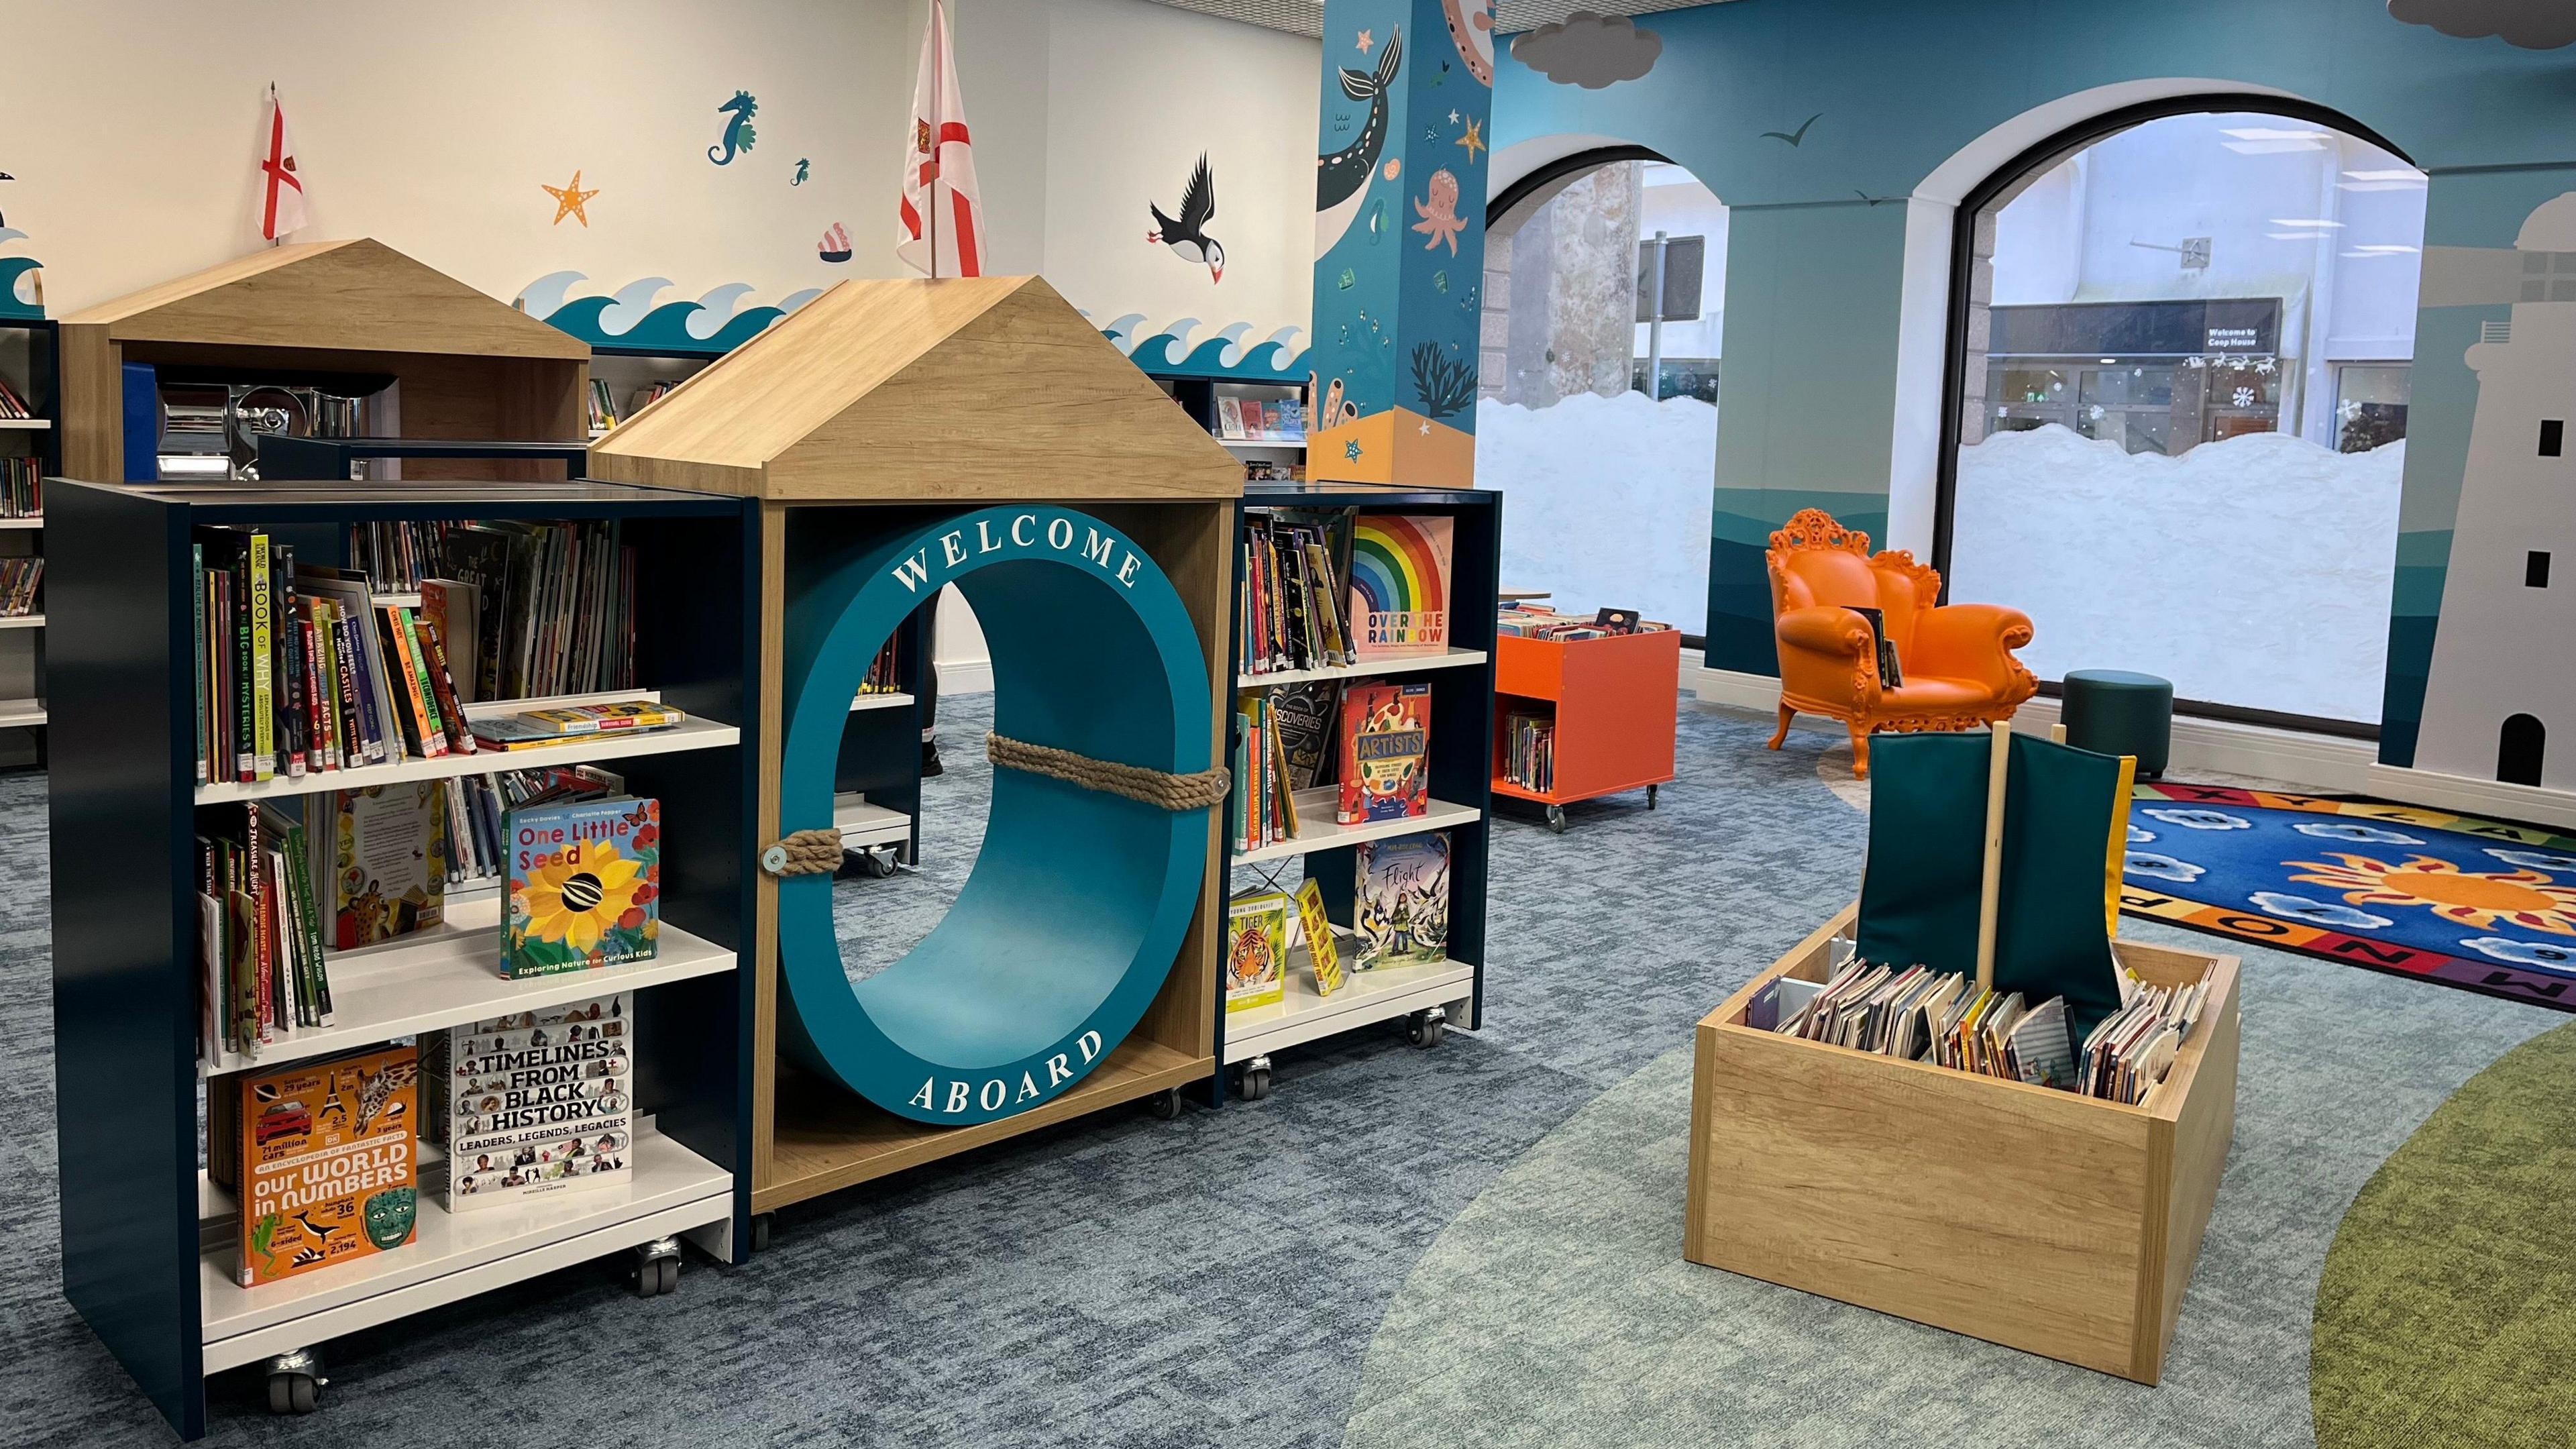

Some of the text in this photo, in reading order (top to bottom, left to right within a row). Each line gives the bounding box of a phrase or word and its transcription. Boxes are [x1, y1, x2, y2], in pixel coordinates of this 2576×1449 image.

[2208, 338, 2256, 347] Coop House
[892, 515, 1141, 593] WELCOME
[458, 569, 487, 588] GREAT
[1368, 613, 1442, 628] OVER THE
[239, 627, 250, 649] BIG
[255, 584, 270, 691] BOOK OF WHY
[339, 606, 356, 675] HOW DO YOU FEEL?
[1368, 629, 1442, 643] RAINBOW
[391, 611, 419, 698] CHRIS HOY BE AMAZING!
[409, 637, 426, 673] MIDDLETON
[435, 645, 446, 666] GHOSTS
[315, 628, 327, 669] AMAZING
[322, 700, 332, 731] FACTS
[335, 638, 356, 737] Haunted CASTLES YVETTE
[242, 682, 252, 741] MYSTERIES
[567, 722, 597, 731] Friendship
[2184, 788, 2241, 802] X
[2273, 794, 2315, 807] Y
[600, 809, 622, 817] Pepper
[2176, 814, 2228, 825] 10
[519, 819, 629, 846] One Little
[2466, 826, 2524, 841] A
[519, 845, 580, 871] Seed
[2132, 859, 2169, 869] 8
[250, 871, 259, 896] HUNT
[1381, 860, 1426, 891] Flight
[1230, 902, 1274, 915] YOUNG ZOOLOGIST
[1240, 914, 1263, 931] TIGER
[2217, 916, 2290, 936] O
[310, 932, 324, 981] Tom Read Wilson
[519, 963, 559, 975] Exploring
[561, 959, 590, 969] Nature
[603, 952, 634, 963] Curious
[635, 949, 651, 958] Kids
[1310, 953, 1319, 968] REALLY
[2332, 941, 2417, 965] N
[1314, 969, 1324, 982] FROM
[2480, 971, 2569, 998] M
[479, 1040, 609, 1074] TIMELINES
[511, 1064, 580, 1089] FROM
[909, 1030, 1102, 1114] ABOARD
[297, 1080, 321, 1091] years
[505, 1082, 585, 1110] BLACK
[332, 1115, 347, 1124] 2.5
[492, 1099, 598, 1131] HISTORY
[383, 1124, 402, 1132] years
[460, 1118, 627, 1152] LEADERS, LEGENDS, LEGACIES
[262, 1138, 307, 1154] 71 million
[327, 1134, 339, 1144] DK
[262, 1150, 285, 1161] cars
[272, 1150, 329, 1169] ENCYCLOPEDIA
[341, 1138, 381, 1152] FANTASTIC
[383, 1132, 405, 1142] FACTS
[255, 1143, 408, 1197] our WORLD
[255, 1199, 275, 1217] in
[337, 1202, 354, 1216] 36
[270, 1234, 303, 1248] 6-sided
[330, 1240, 357, 1254] 2,194
